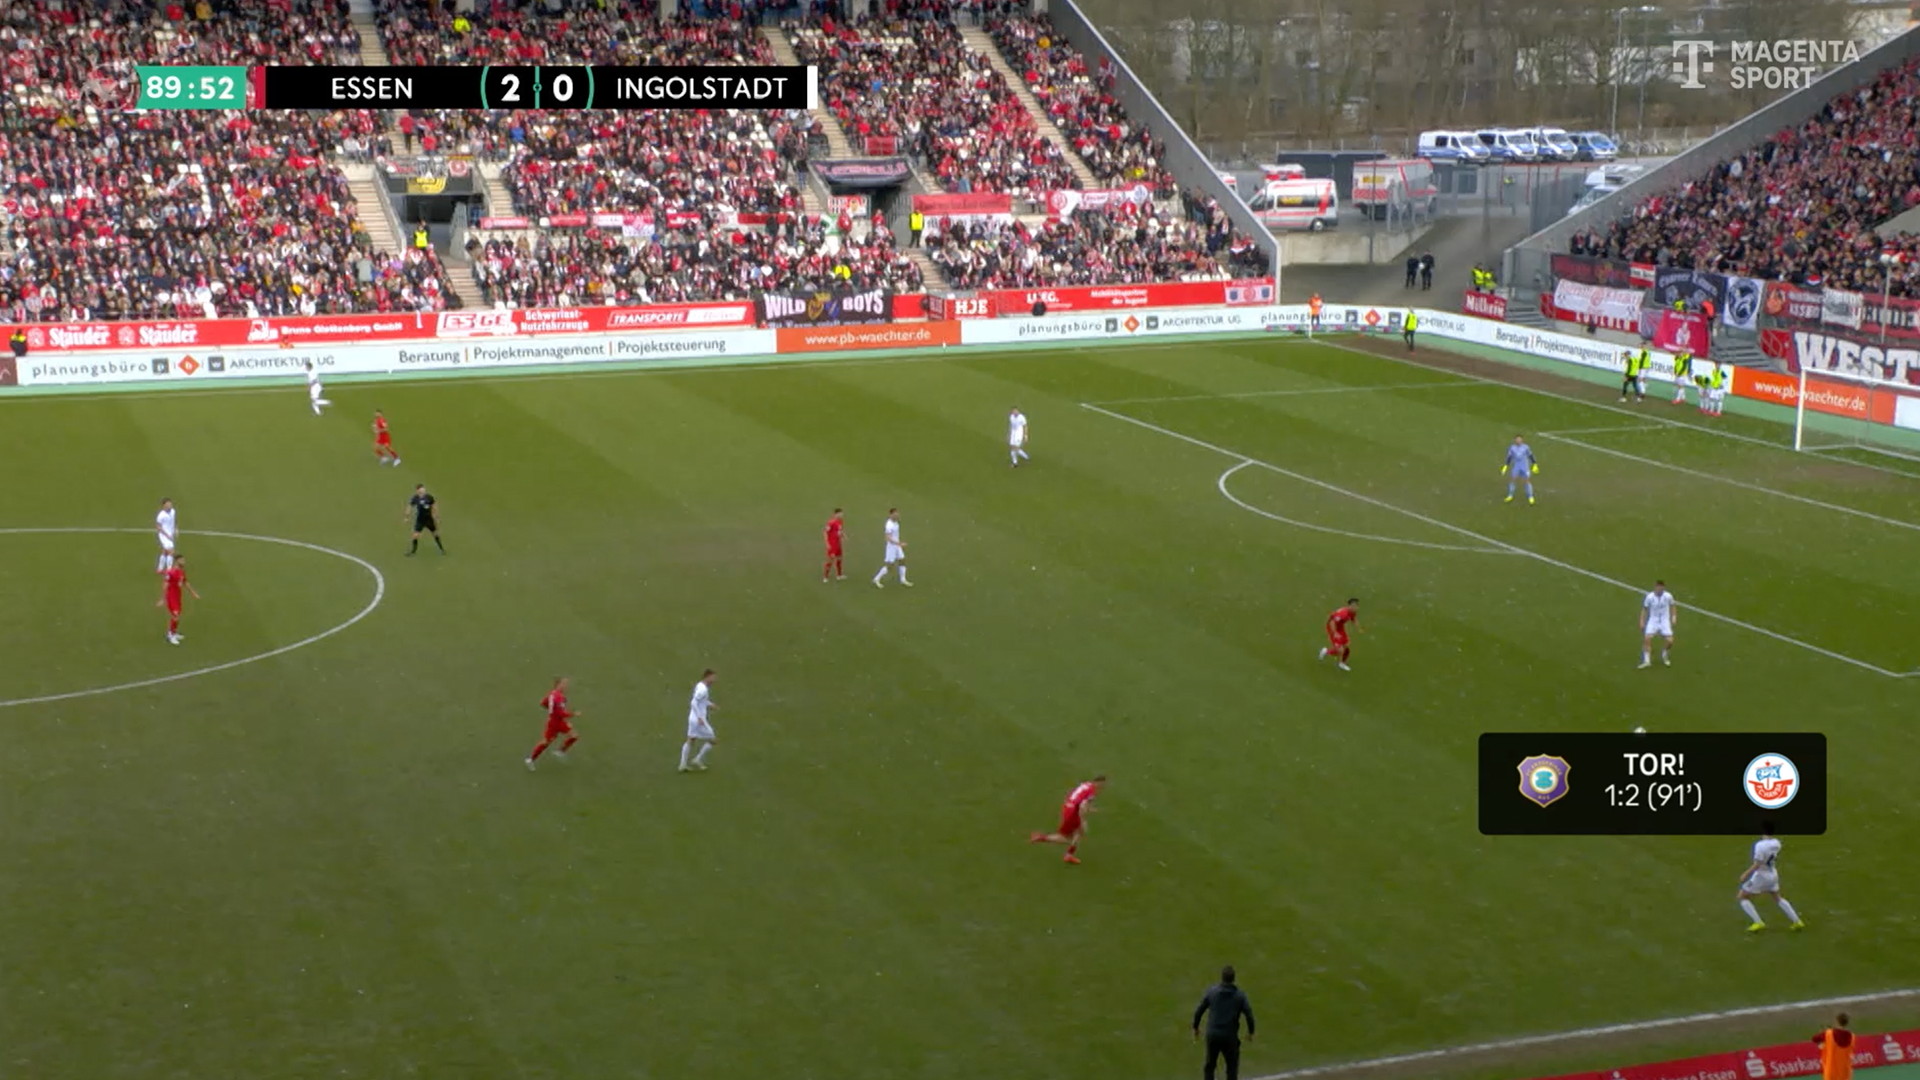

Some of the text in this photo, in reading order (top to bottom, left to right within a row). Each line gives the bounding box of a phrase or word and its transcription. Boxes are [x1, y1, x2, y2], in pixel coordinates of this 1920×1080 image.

[764, 294, 806, 319] WILD
[843, 290, 884, 315] BOYS
[955, 299, 989, 315] HJE
[612, 312, 685, 325] TRANSPORTE
[1019, 321, 1102, 336] planungsbüro
[1162, 316, 1223, 327] ARCHITEKTUR
[1228, 314, 1241, 323] UG
[50, 326, 110, 348] Stauder
[139, 325, 198, 347] Stauder
[805, 328, 931, 345] www.pb-waechter.de
[474, 345, 604, 361] Projektmanagement
[617, 338, 726, 354] Projektsteuerung
[1496, 328, 1612, 364] Beratung Projektmanagement
[399, 350, 460, 364] Beratung
[32, 360, 148, 379] planungsbüro
[230, 356, 311, 369] ARCHITEKTUR
[317, 355, 335, 366] UG
